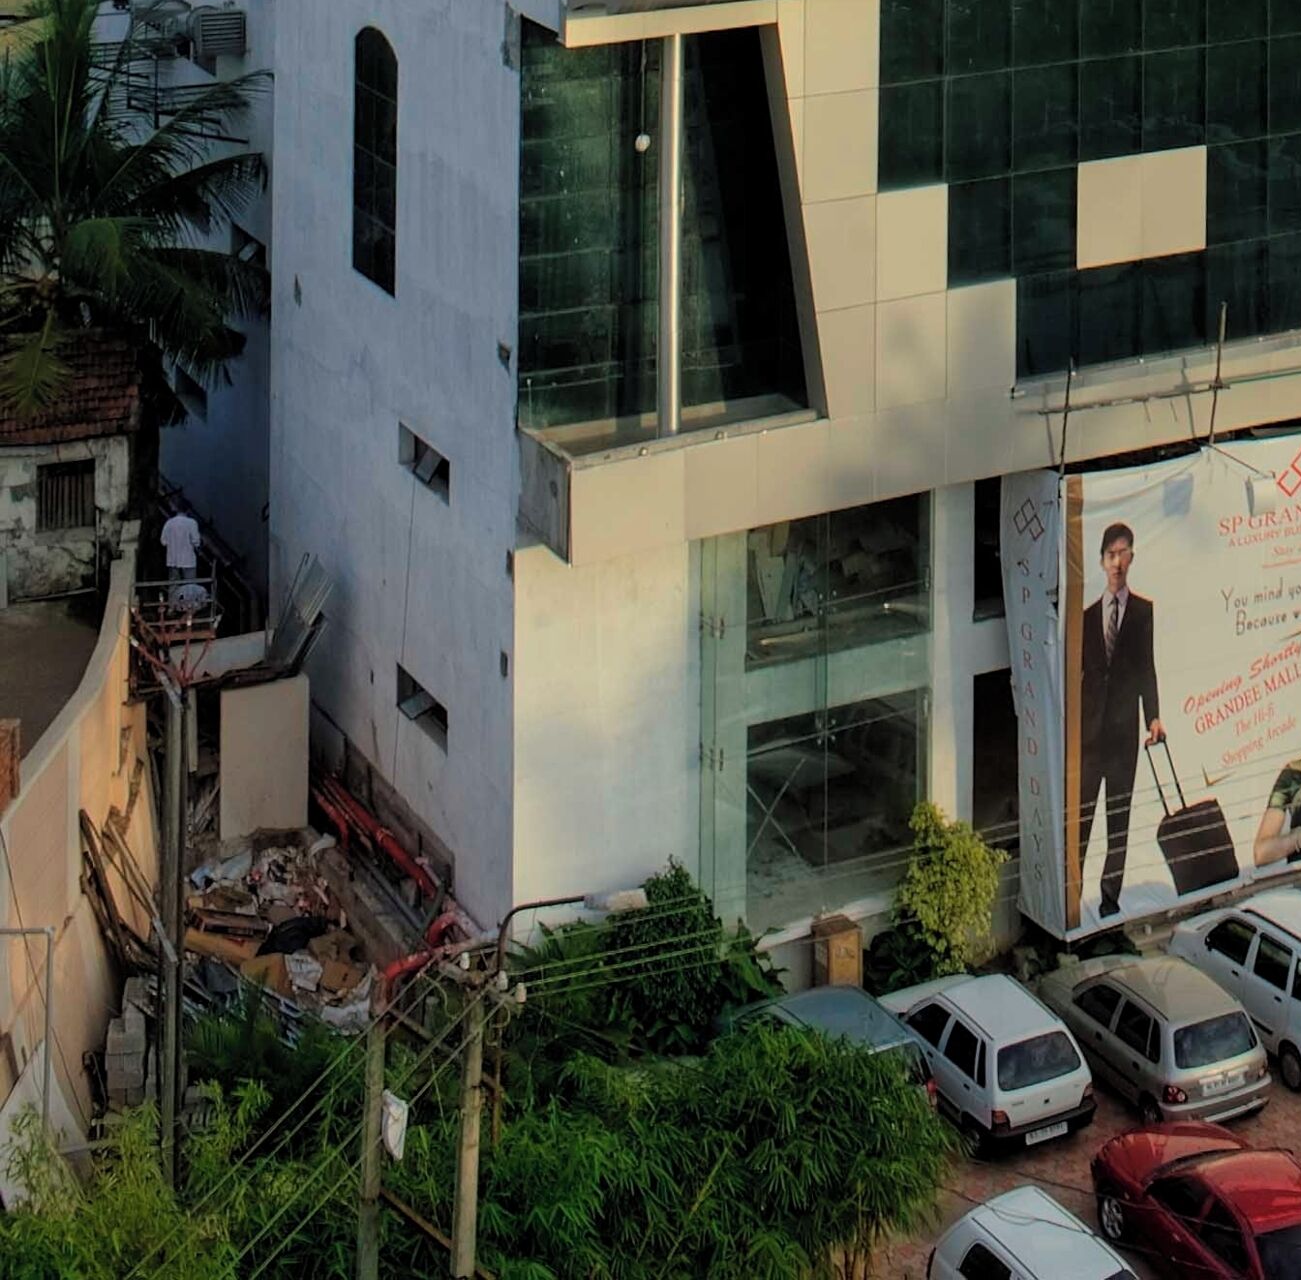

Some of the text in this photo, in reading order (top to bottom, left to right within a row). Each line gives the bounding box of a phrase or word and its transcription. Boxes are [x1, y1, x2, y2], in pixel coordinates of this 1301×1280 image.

[1219, 516, 1243, 535] SP
[1237, 529, 1281, 546] LUXURY
[1221, 587, 1248, 613] You
[1254, 577, 1283, 604] mind
[1236, 609, 1287, 636] Because
[1184, 675, 1242, 715] Opening
[1195, 686, 1262, 734] GRANDEE
[1021, 623, 1038, 756] GRAND
[1031, 777, 1042, 881] DAYS
